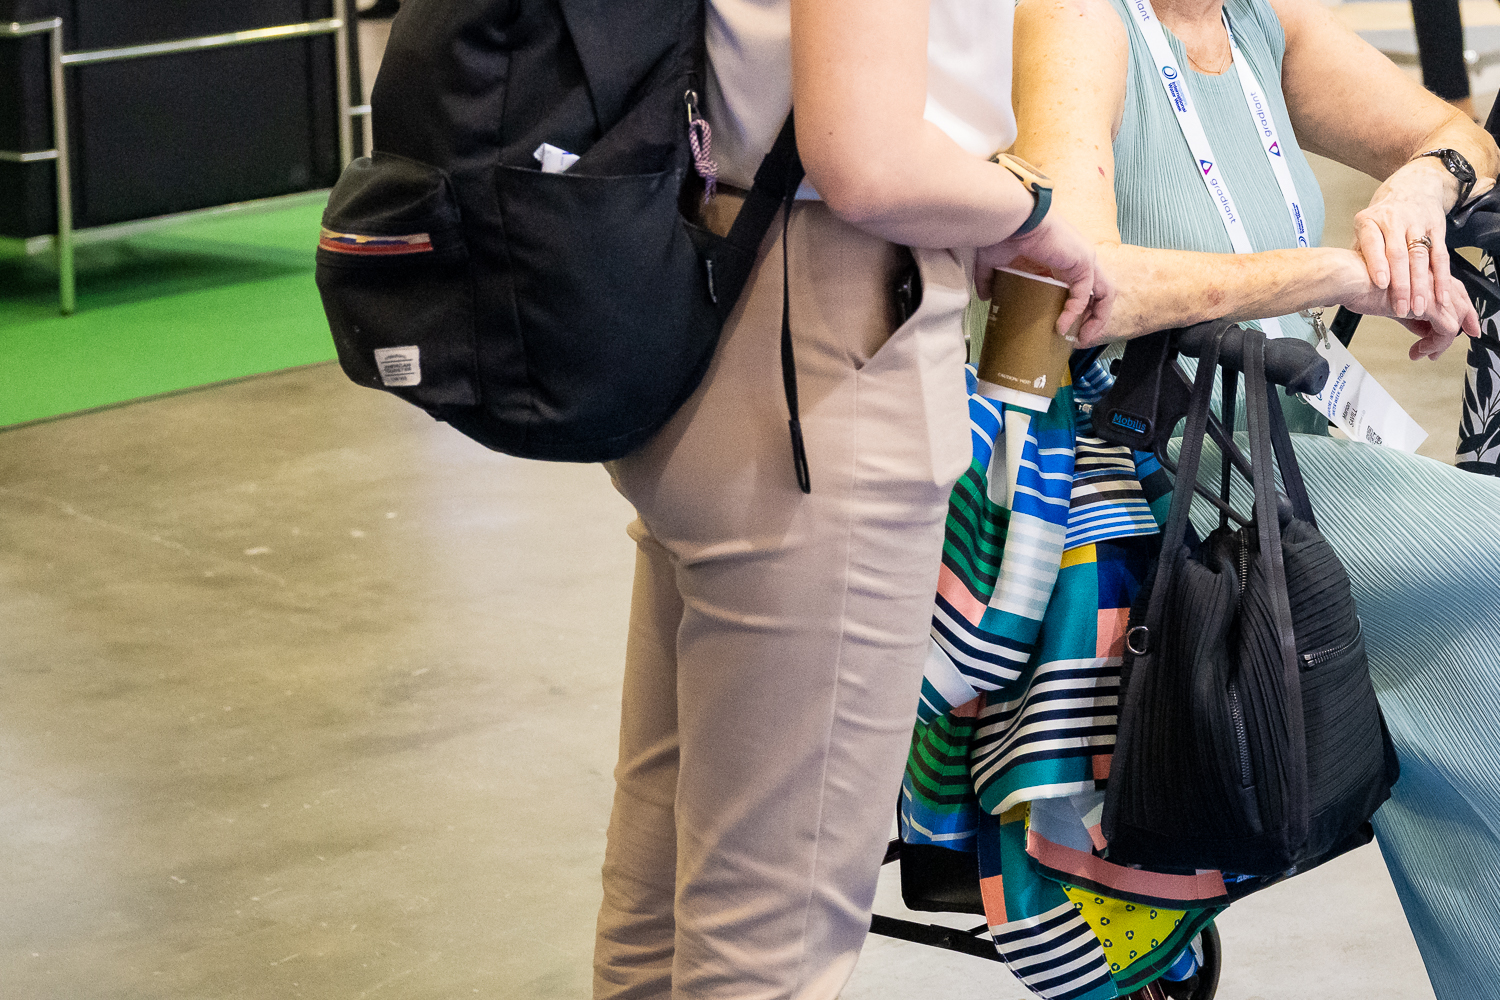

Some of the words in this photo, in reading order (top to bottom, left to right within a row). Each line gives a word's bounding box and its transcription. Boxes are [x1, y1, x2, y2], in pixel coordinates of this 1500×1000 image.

[1172, 81, 1187, 113] International
[1250, 92, 1273, 138] gradiant
[1210, 178, 1236, 224] gradiant
[1330, 363, 1350, 400] INTERNATIONAL
[1112, 413, 1147, 430] Mobilis
[1342, 401, 1351, 420] Marion
